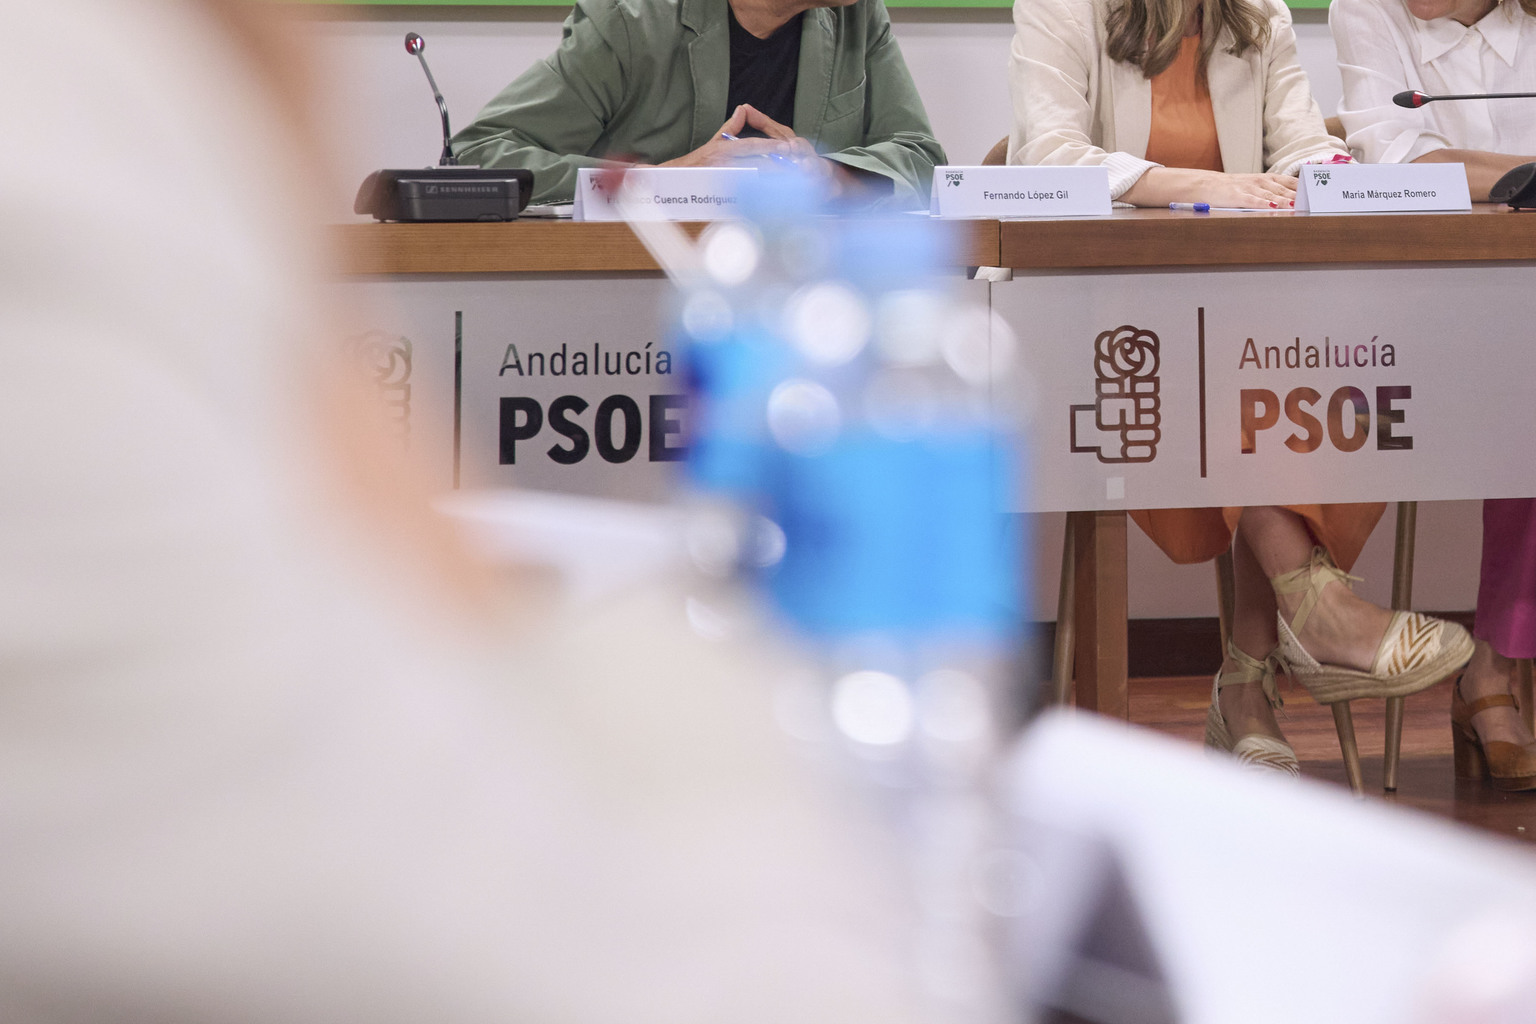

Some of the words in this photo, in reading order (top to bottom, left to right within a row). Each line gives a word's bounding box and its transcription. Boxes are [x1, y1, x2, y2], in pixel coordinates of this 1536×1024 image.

[653, 195, 688, 204] Cuenca
[983, 191, 1025, 200] Fernando
[1028, 190, 1054, 201] López
[1056, 190, 1069, 199] Gil
[1404, 189, 1437, 198] Romero
[498, 342, 673, 377] Andalucía
[1238, 335, 1397, 370] Andalucía
[498, 394, 690, 466] PSOE
[1239, 385, 1414, 455] PSOE
